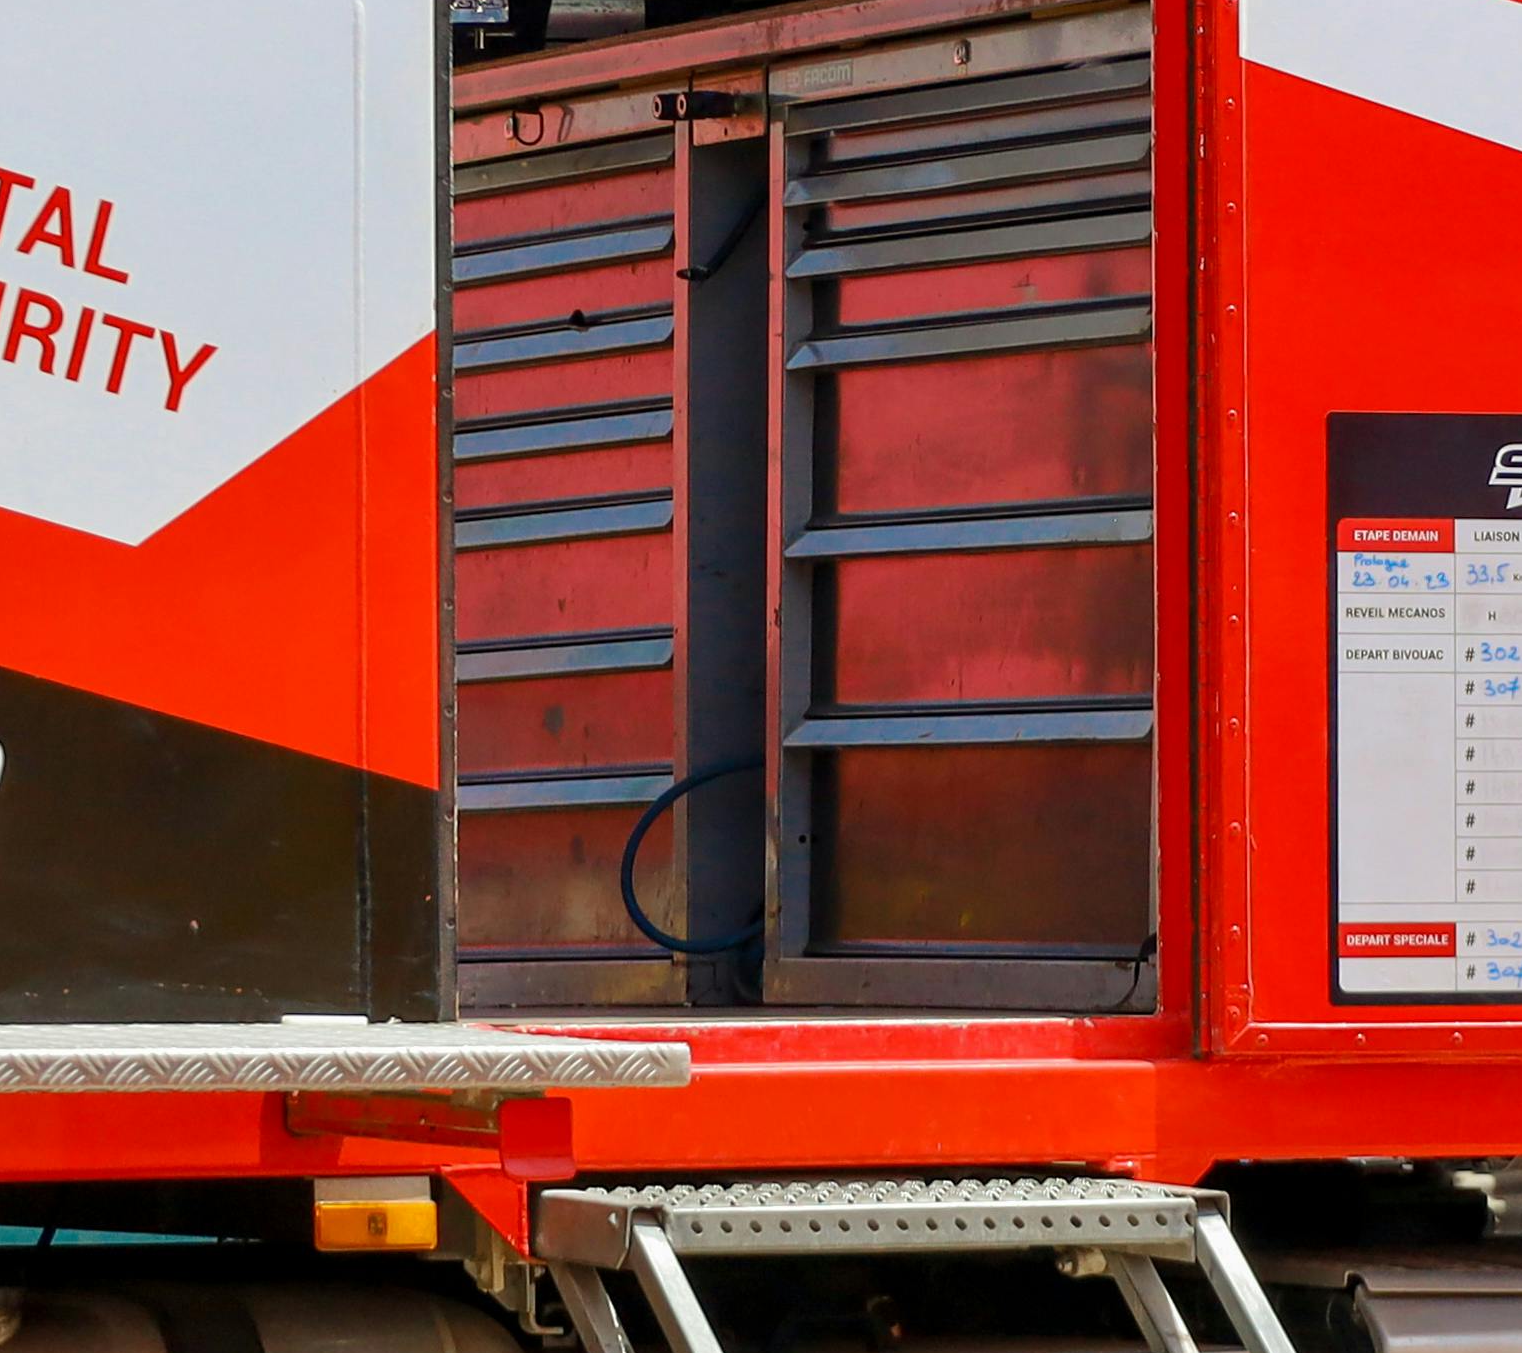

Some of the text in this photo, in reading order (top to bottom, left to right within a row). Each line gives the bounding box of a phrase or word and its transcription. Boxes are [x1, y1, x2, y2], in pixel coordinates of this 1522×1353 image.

[804, 63, 852, 88] FACOM
[1354, 530, 1438, 542] ETAPE DEMAIN
[1474, 531, 1520, 542] LIAISON
[1346, 607, 1496, 620] REVEIL MECANOS H
[1346, 650, 1443, 660] DEPART BIVOUAC
[1481, 643, 1520, 662] 302
[1346, 934, 1449, 946] DEPART SPECIALE
